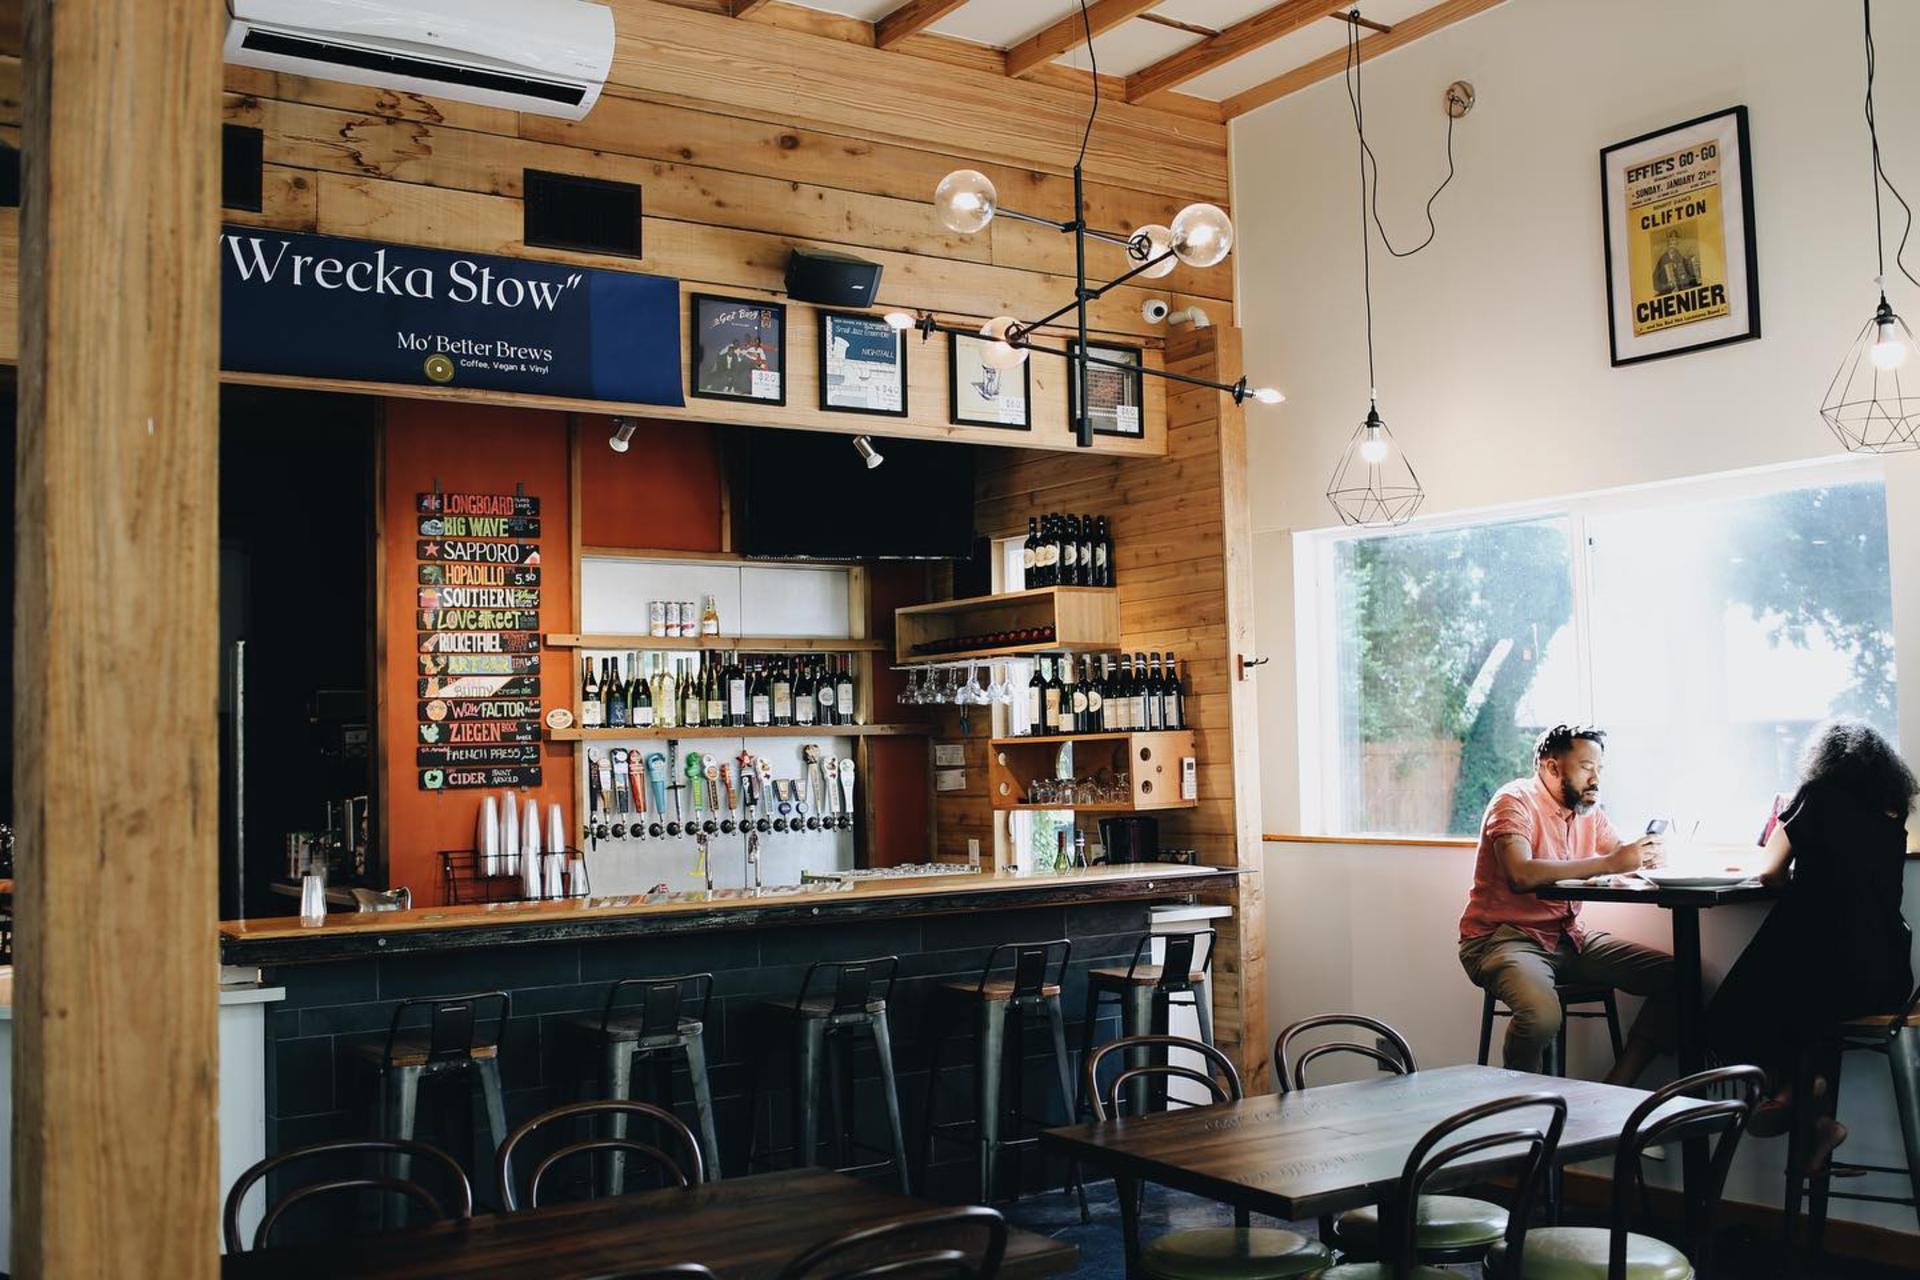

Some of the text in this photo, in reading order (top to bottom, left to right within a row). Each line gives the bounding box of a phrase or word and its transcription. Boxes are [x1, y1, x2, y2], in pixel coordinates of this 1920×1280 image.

[1627, 157, 1675, 184] EFFIE'S
[1666, 174, 1695, 189] JANUARY
[1641, 200, 1707, 230] CLIFTON
[1636, 284, 1726, 323] CHENIER
[437, 335, 493, 357] Better
[496, 340, 553, 362] Brews
[460, 358, 550, 375] Coffee, Vegan & Vinyl
[444, 494, 515, 516] LONGBOARD
[443, 516, 466, 536] BIG
[468, 518, 509, 537] WAVE
[443, 541, 520, 564] SAPPORO
[445, 564, 505, 586] HOPADILLO
[443, 588, 516, 609] SOUTHERN
[481, 701, 525, 718] FACTOR
[449, 722, 501, 742] ZIEGEN
[490, 747, 521, 760] PRESS
[447, 771, 488, 785] CIDER
